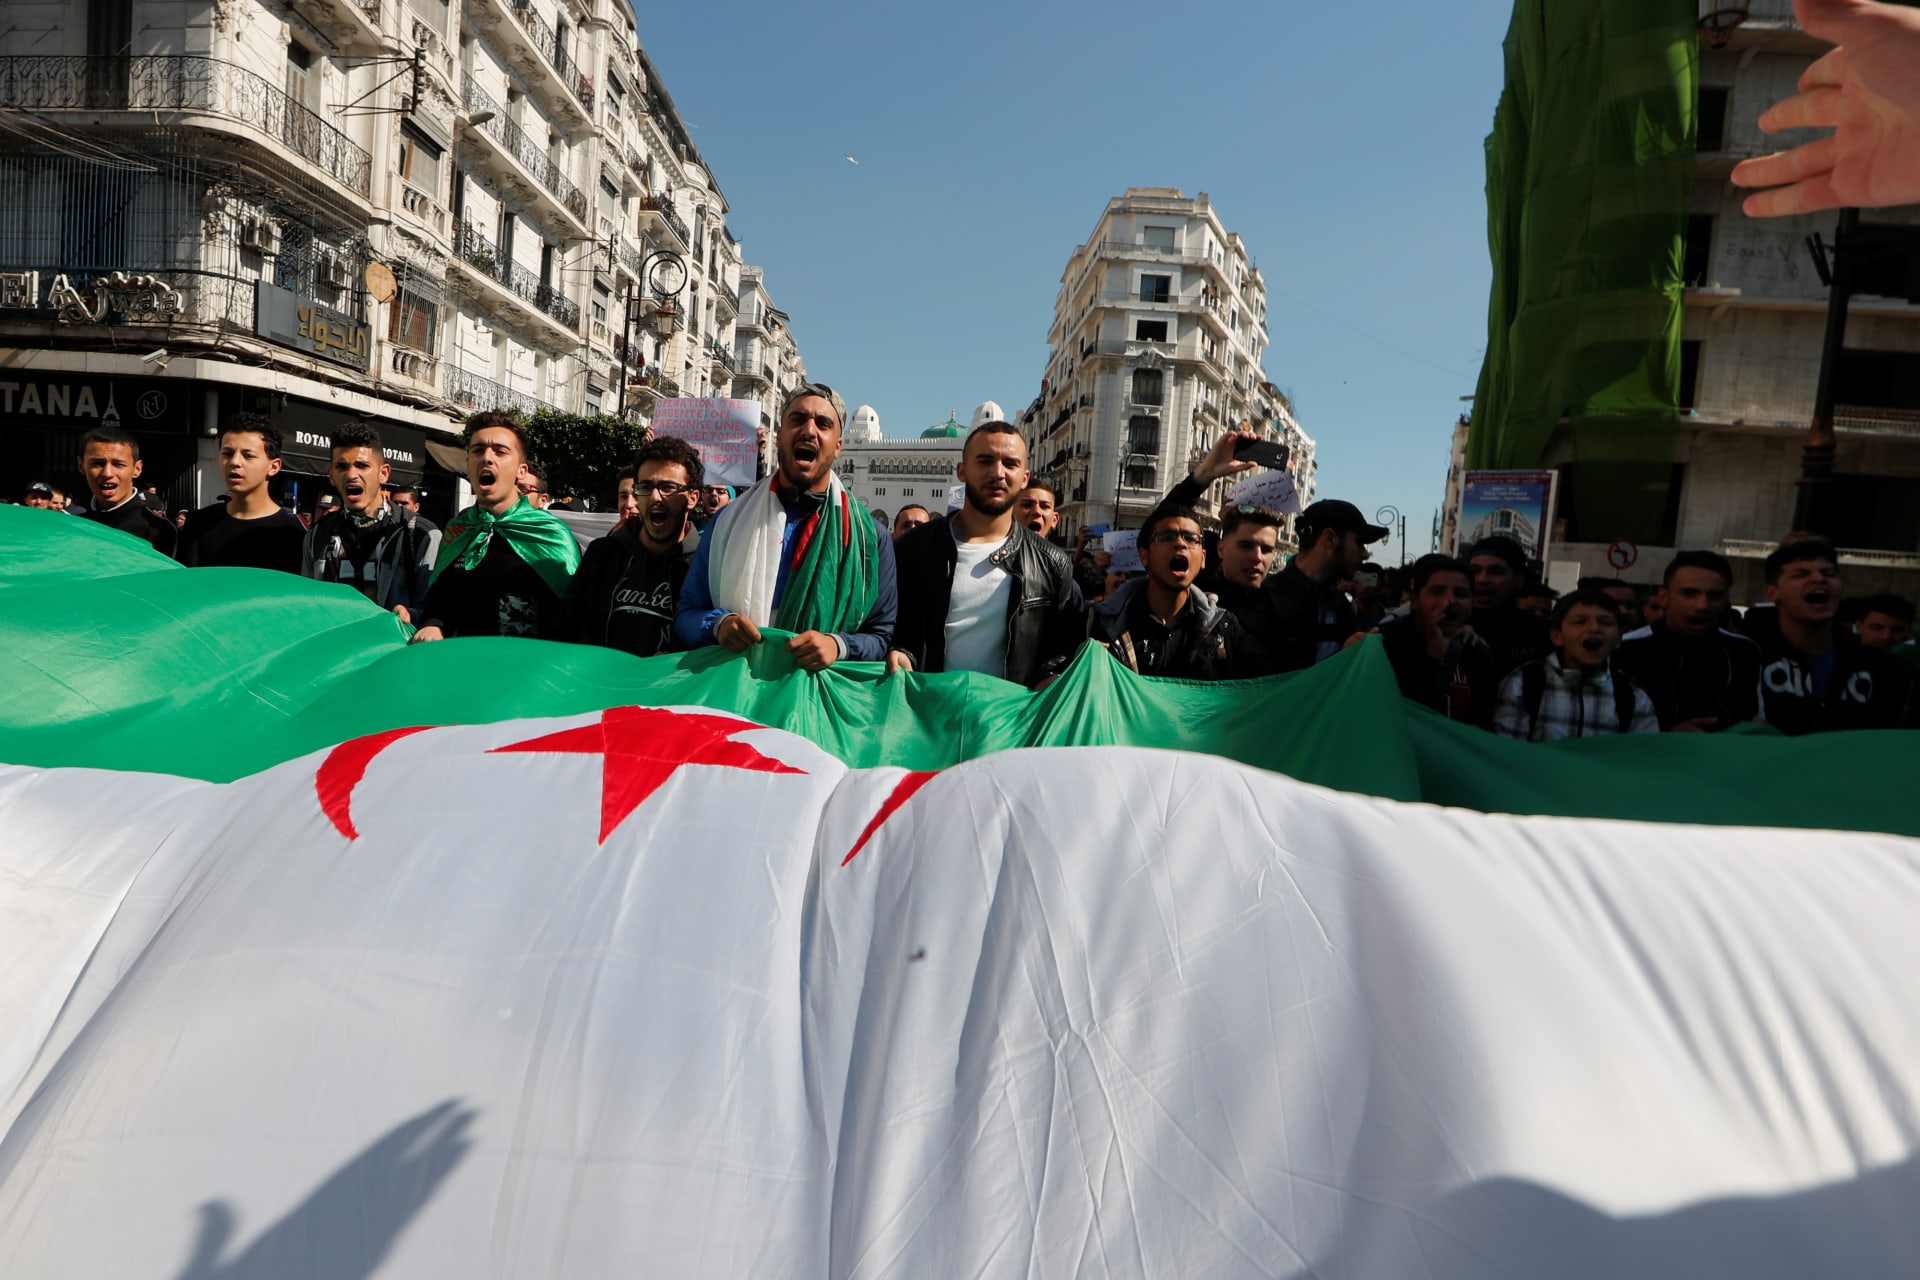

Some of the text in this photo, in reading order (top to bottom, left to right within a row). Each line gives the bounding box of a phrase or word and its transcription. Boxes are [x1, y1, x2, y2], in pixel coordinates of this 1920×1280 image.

[656, 399, 750, 409] OPERATION TRES
[654, 409, 730, 419] URGENTE ON
[715, 420, 741, 431] UNE
[295, 431, 331, 449] ROTAN
